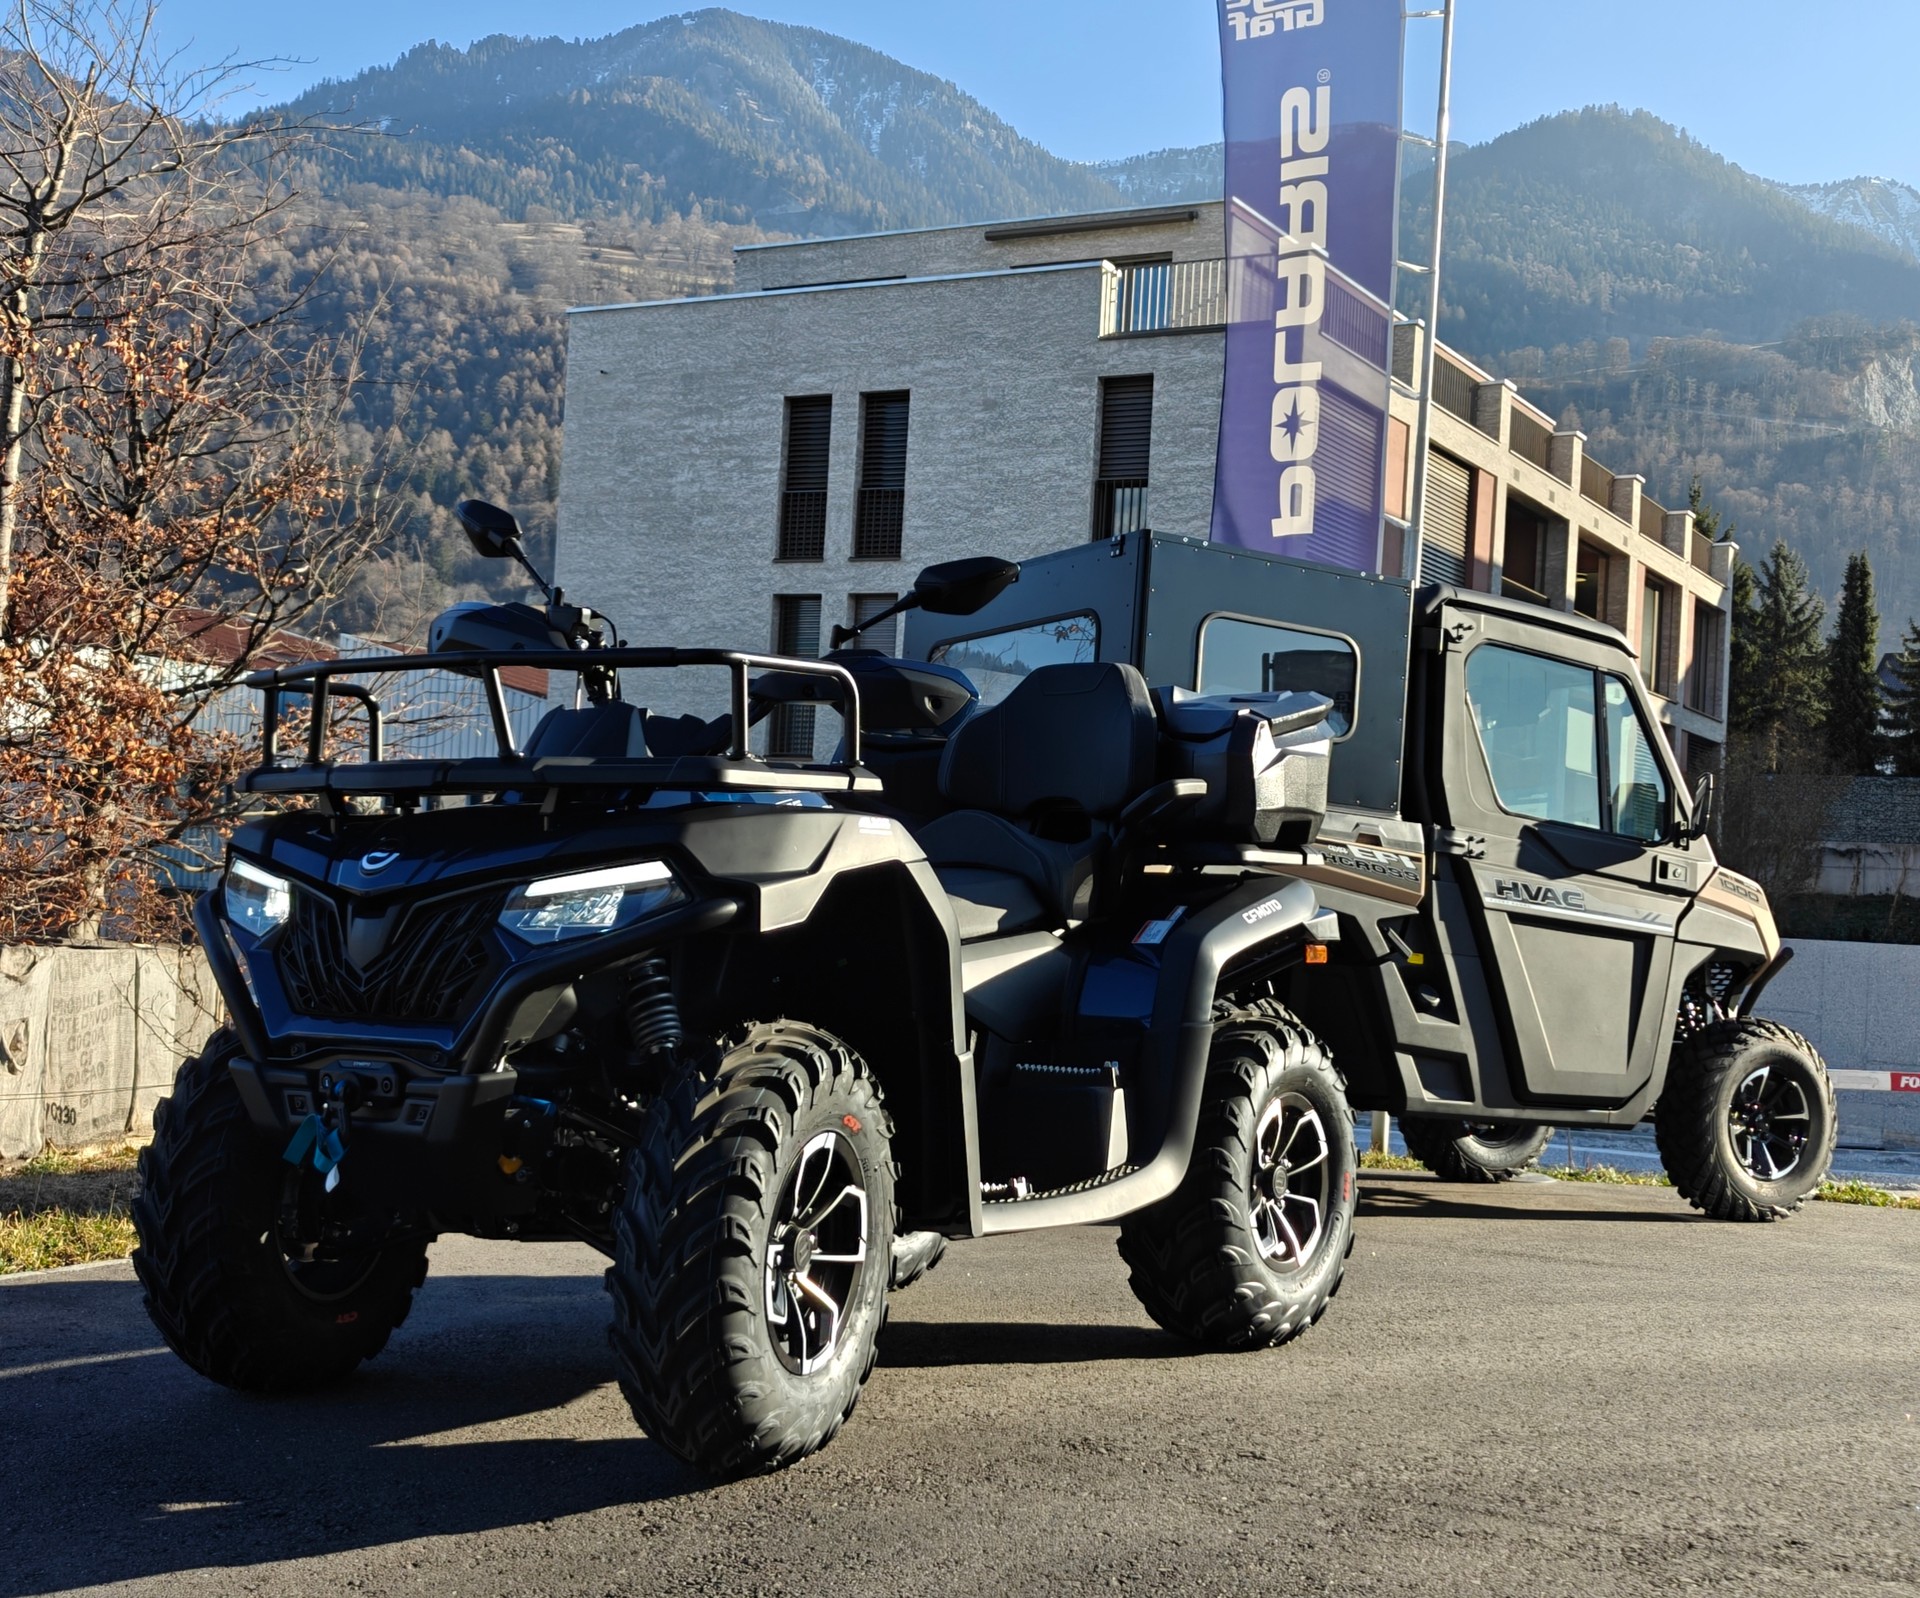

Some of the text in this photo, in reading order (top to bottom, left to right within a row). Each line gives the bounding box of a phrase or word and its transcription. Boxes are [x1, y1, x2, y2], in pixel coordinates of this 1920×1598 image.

[1493, 878, 1585, 911] HVAC
[1241, 898, 1283, 924] CFMOTO
[1900, 1076, 1920, 1089] FO
